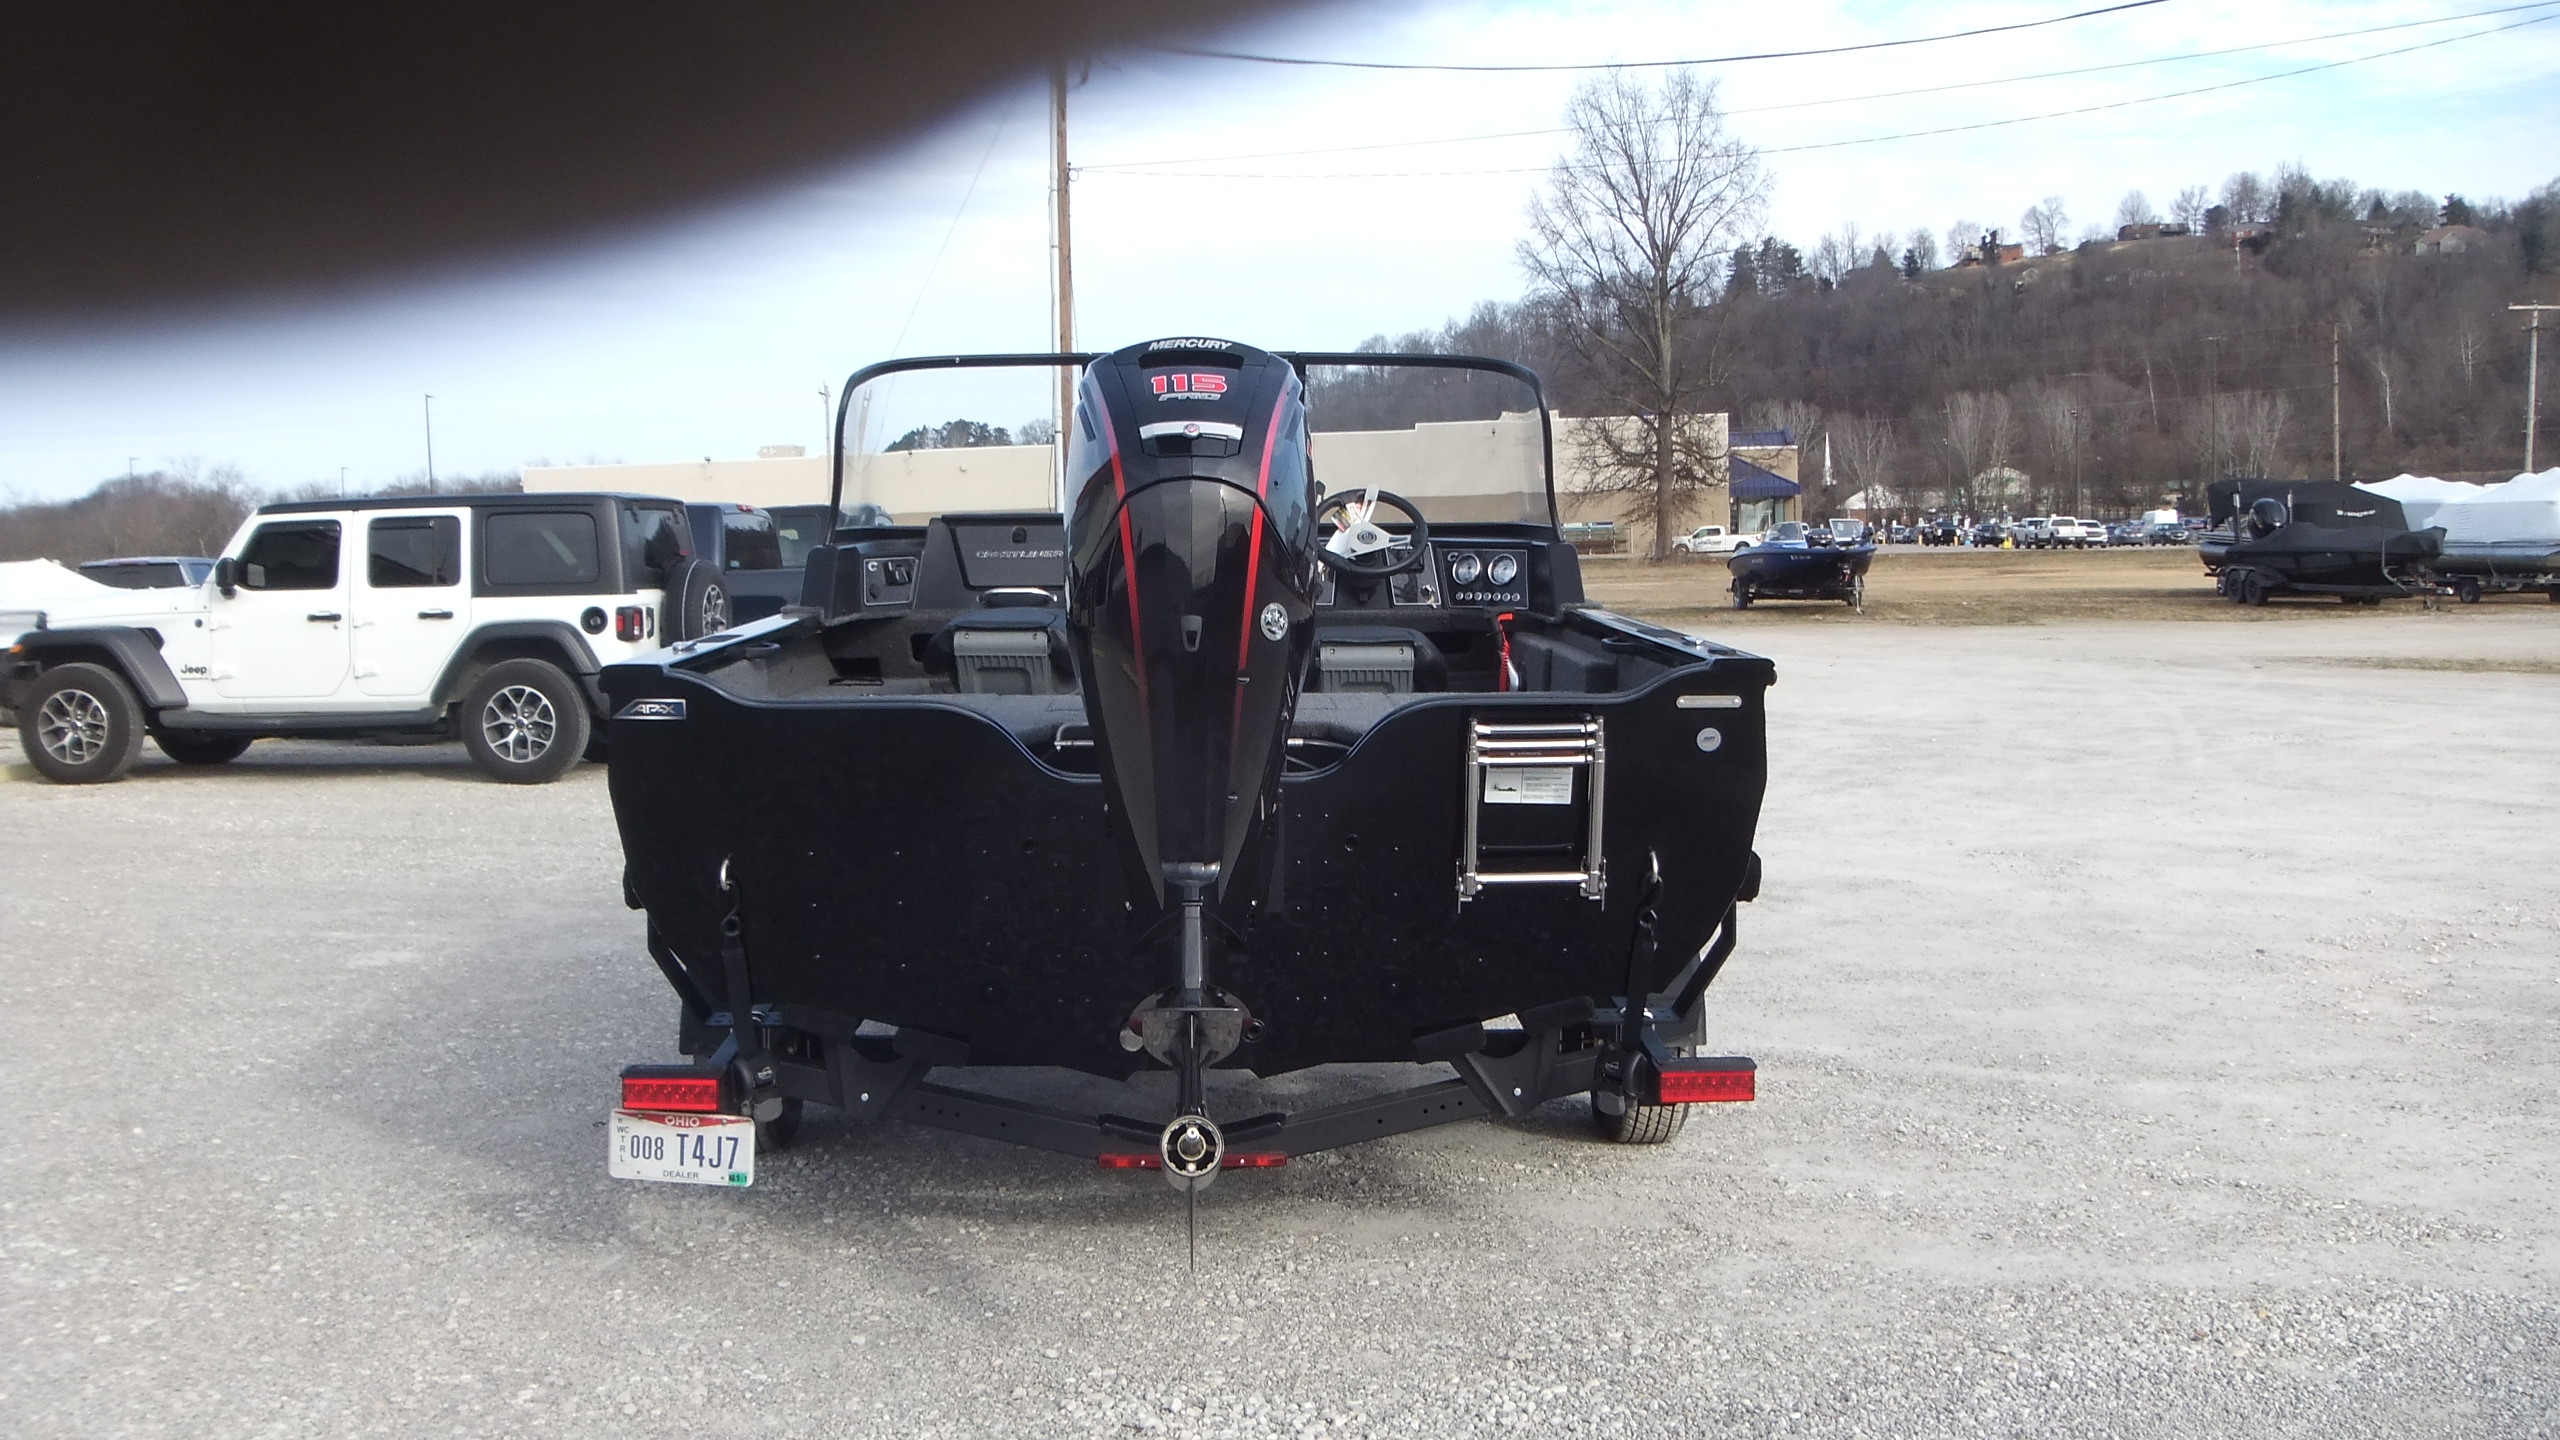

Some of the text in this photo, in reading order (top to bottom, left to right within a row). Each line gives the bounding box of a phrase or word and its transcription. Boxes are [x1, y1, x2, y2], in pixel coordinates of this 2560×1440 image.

[1148, 339, 1232, 351] MERCURY
[1151, 373, 1227, 394] 115
[180, 664, 207, 675] Jeep
[664, 1115, 700, 1127] OHIO
[630, 1133, 739, 1169] 008 T4J7
[662, 1169, 699, 1179] DEALER
